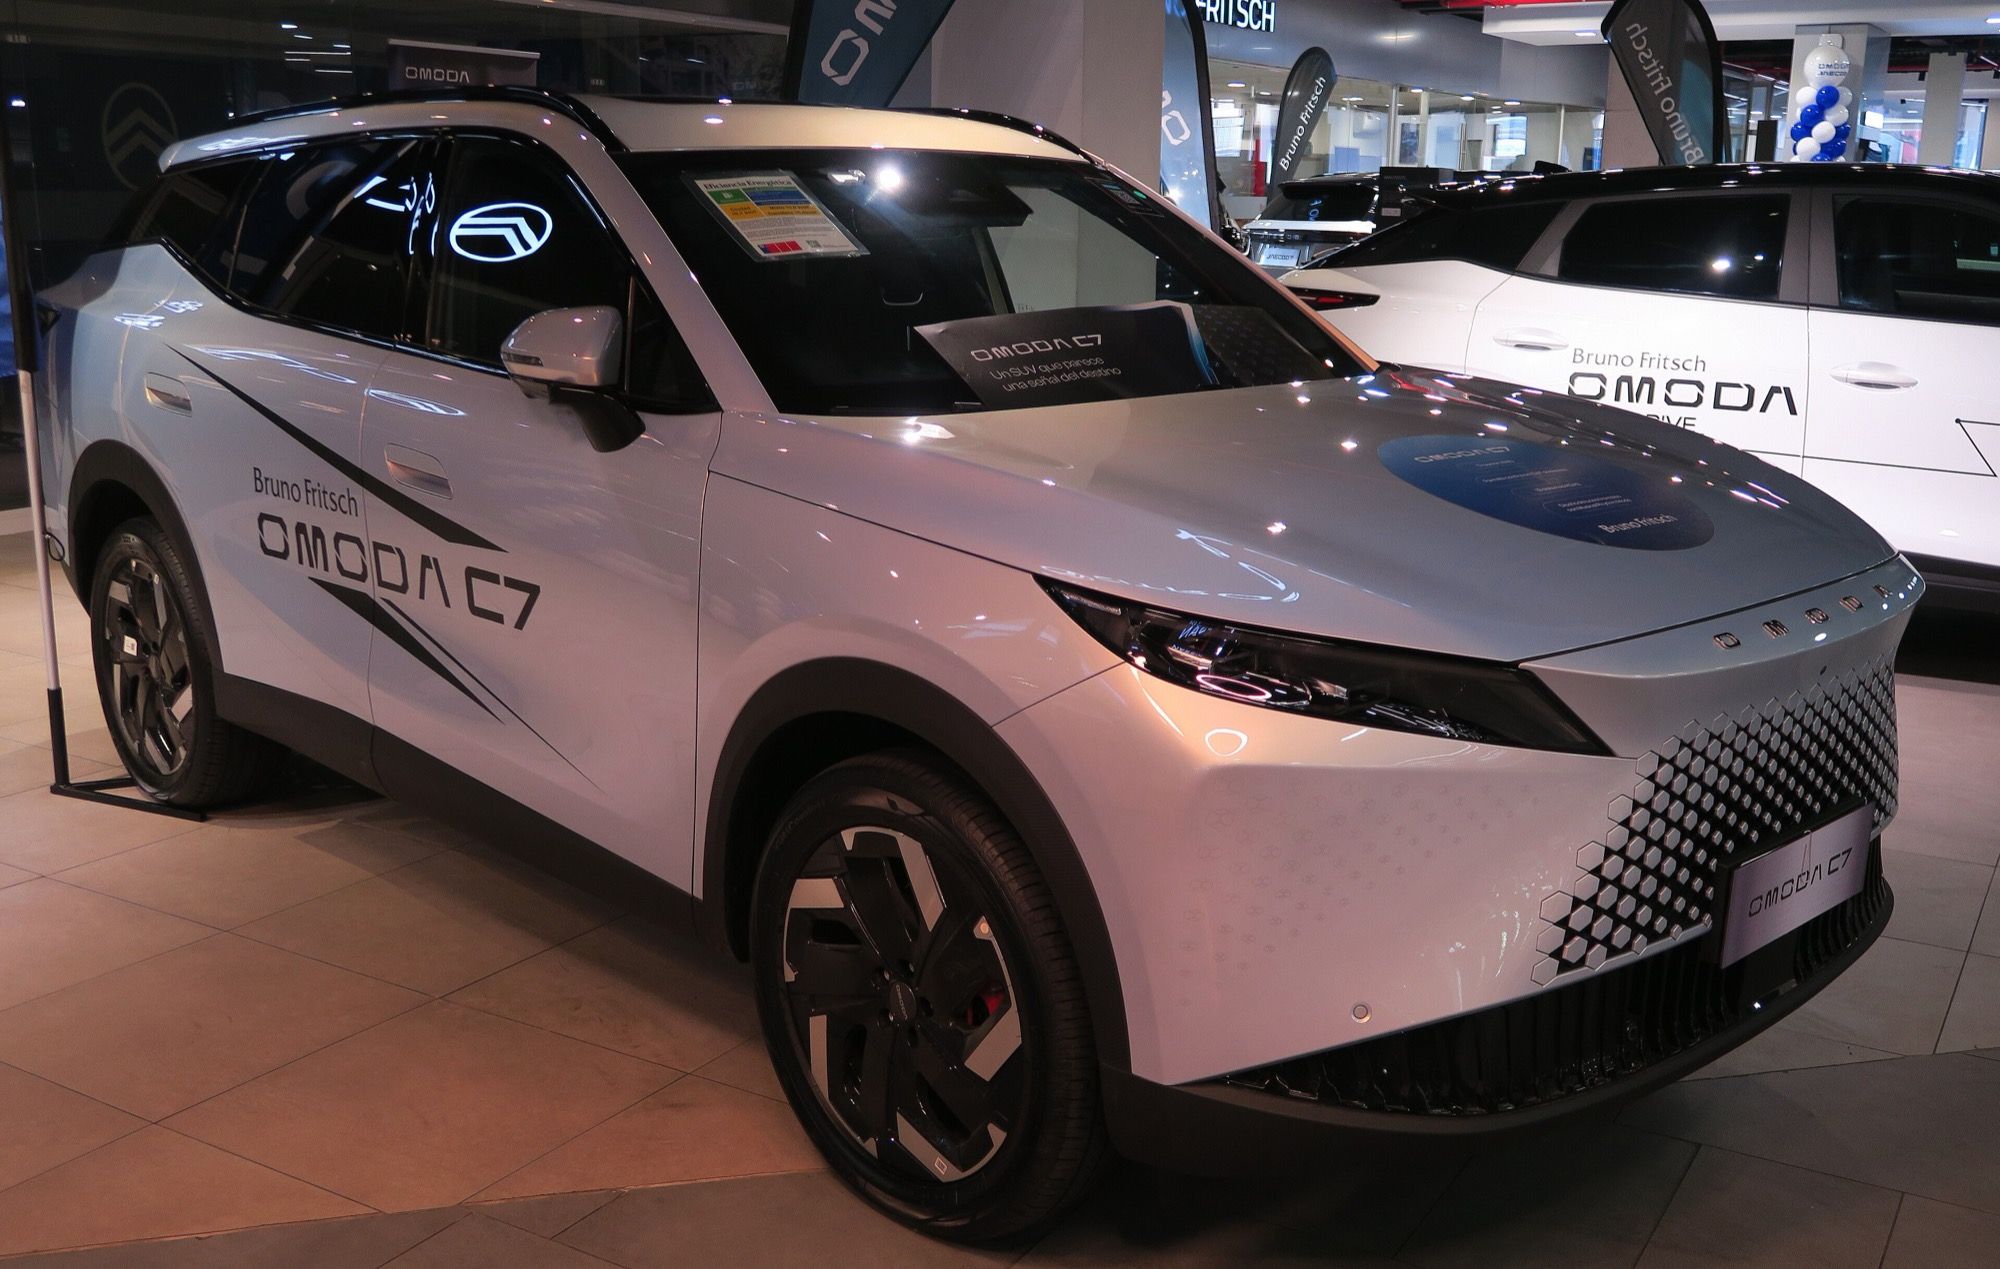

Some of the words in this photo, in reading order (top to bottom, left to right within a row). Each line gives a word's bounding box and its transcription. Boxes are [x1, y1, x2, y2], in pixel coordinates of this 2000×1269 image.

[405, 66, 470, 84] OMODA
[1279, 125, 1305, 172] Bruno
[1299, 75, 1326, 126] Fritsch
[971, 338, 1072, 362] OMODA
[1072, 334, 1102, 348] C7
[1572, 348, 1634, 368] Bruno
[1640, 351, 1707, 372] Fritsch
[989, 369, 1012, 380] Un
[1010, 364, 1037, 377] SUV
[1038, 361, 1063, 373] que
[1063, 357, 1105, 370] parece
[1002, 380, 1029, 392] una
[1027, 374, 1061, 388] señal
[1060, 370, 1081, 383] del
[1079, 366, 1122, 379] destino
[1567, 372, 1798, 416] OMODA
[253, 467, 301, 503] Bruno
[304, 479, 359, 517] Fritsch
[1598, 521, 1641, 534] Bruno
[1633, 513, 1679, 527] Fritsch
[257, 512, 451, 608] OMODA
[465, 566, 541, 630] C7
[1749, 863, 1822, 918] OMODA
[1827, 848, 1853, 876] C7
